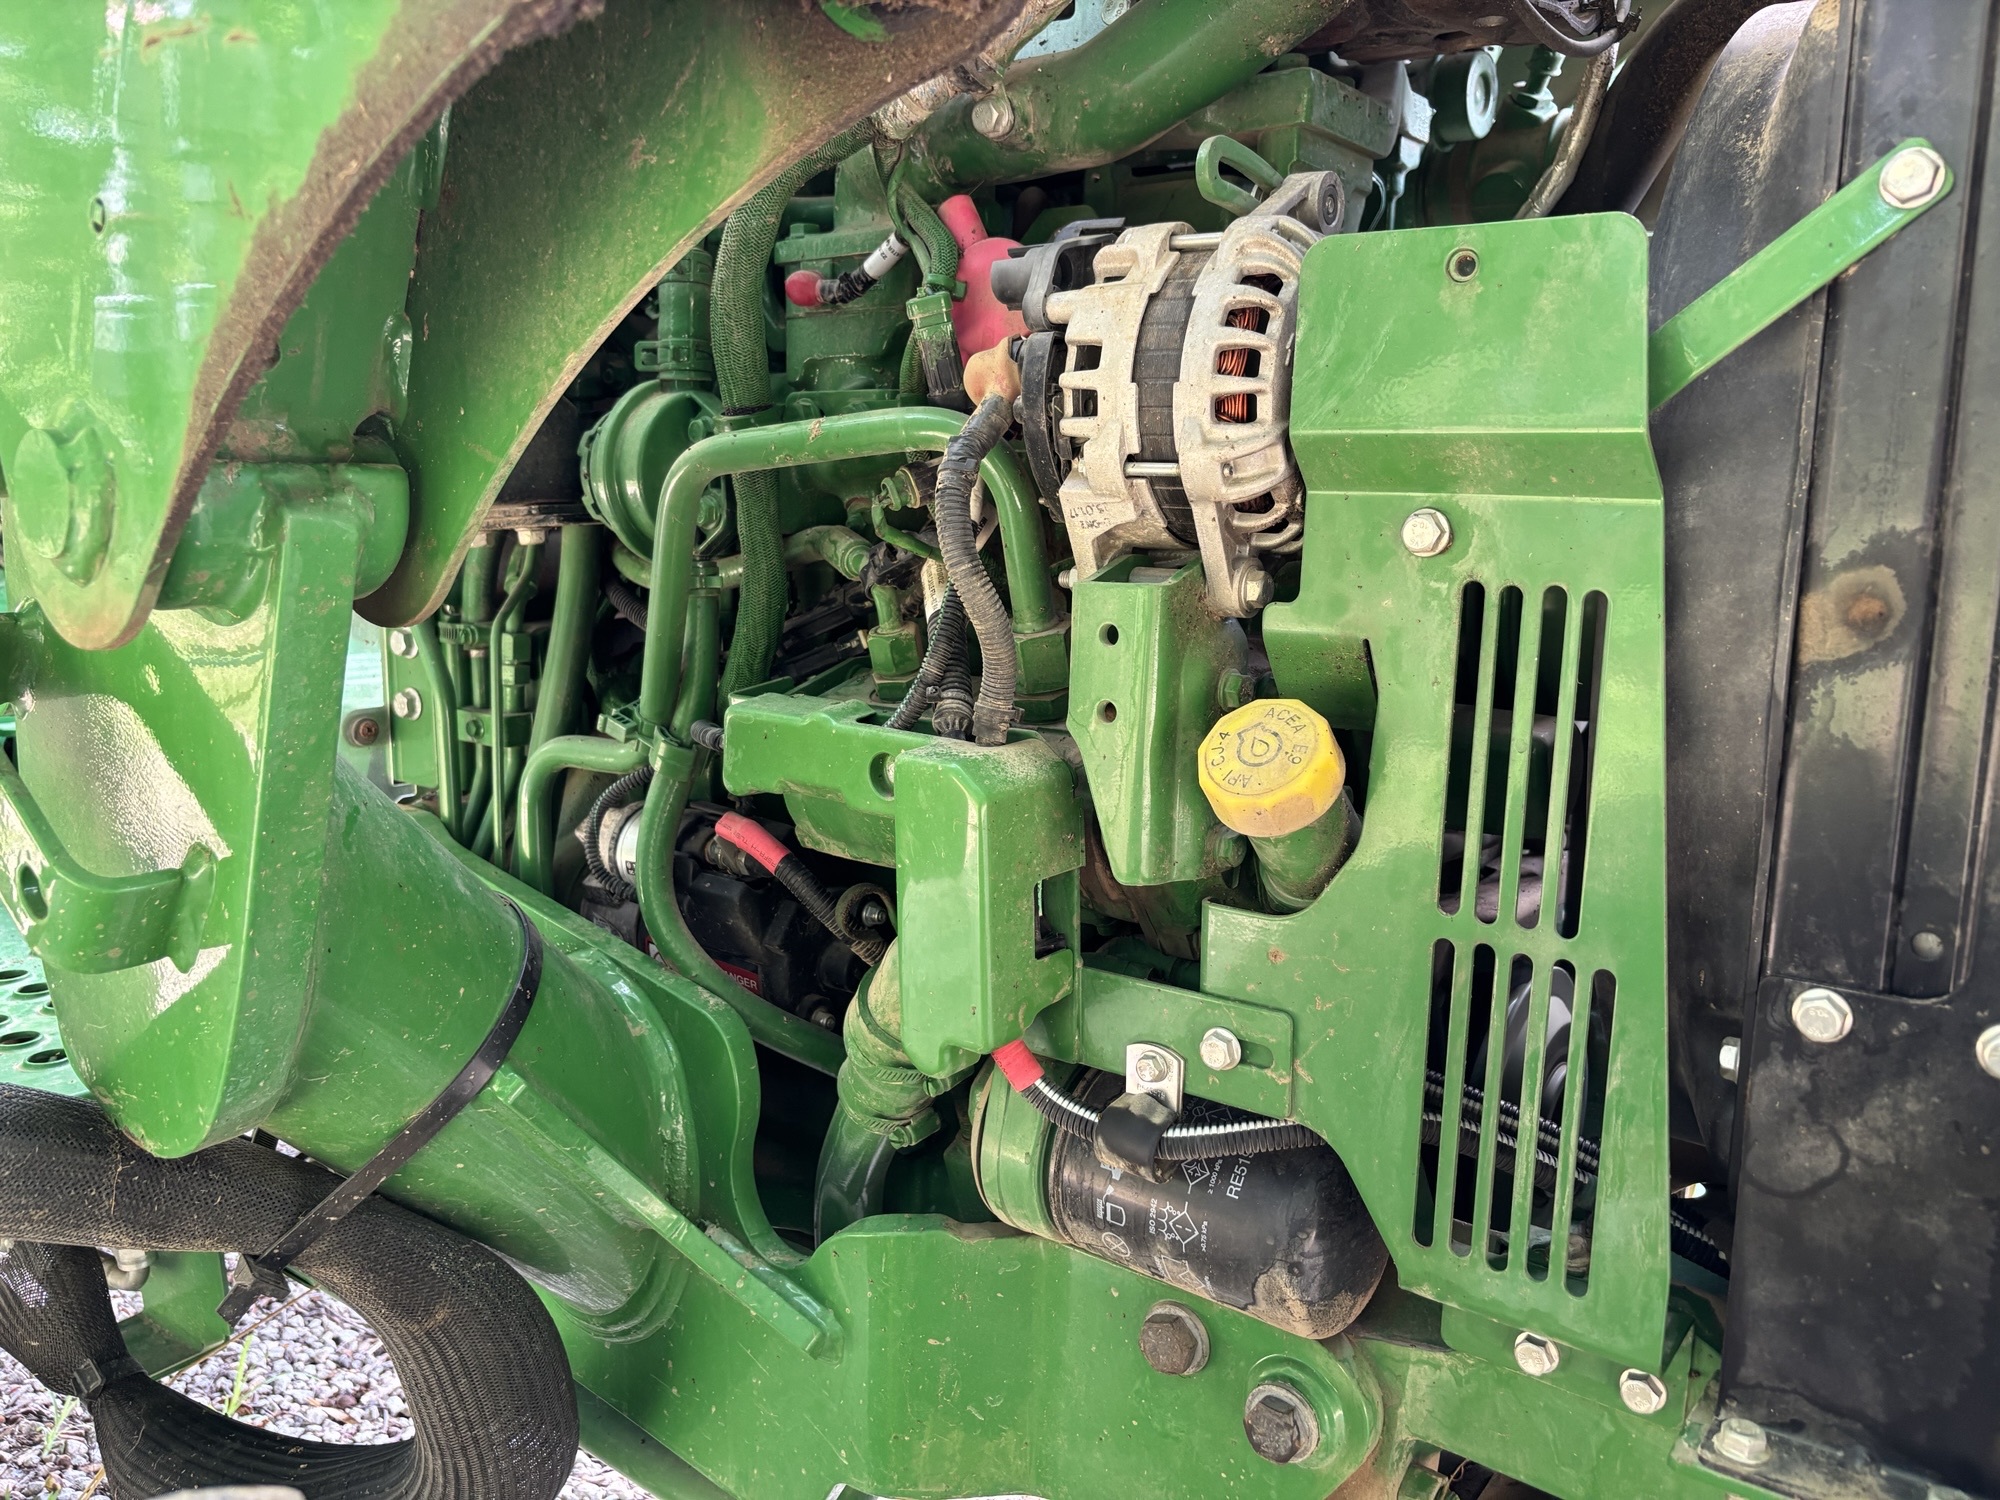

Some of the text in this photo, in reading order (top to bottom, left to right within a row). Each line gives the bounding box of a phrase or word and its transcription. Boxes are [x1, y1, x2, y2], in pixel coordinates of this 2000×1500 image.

[1264, 707, 1307, 734] ACEA
[1211, 731, 1252, 788] API CJ-4
[1209, 1171, 1218, 1187] 1000
[1149, 1198, 1157, 1219] 2942
